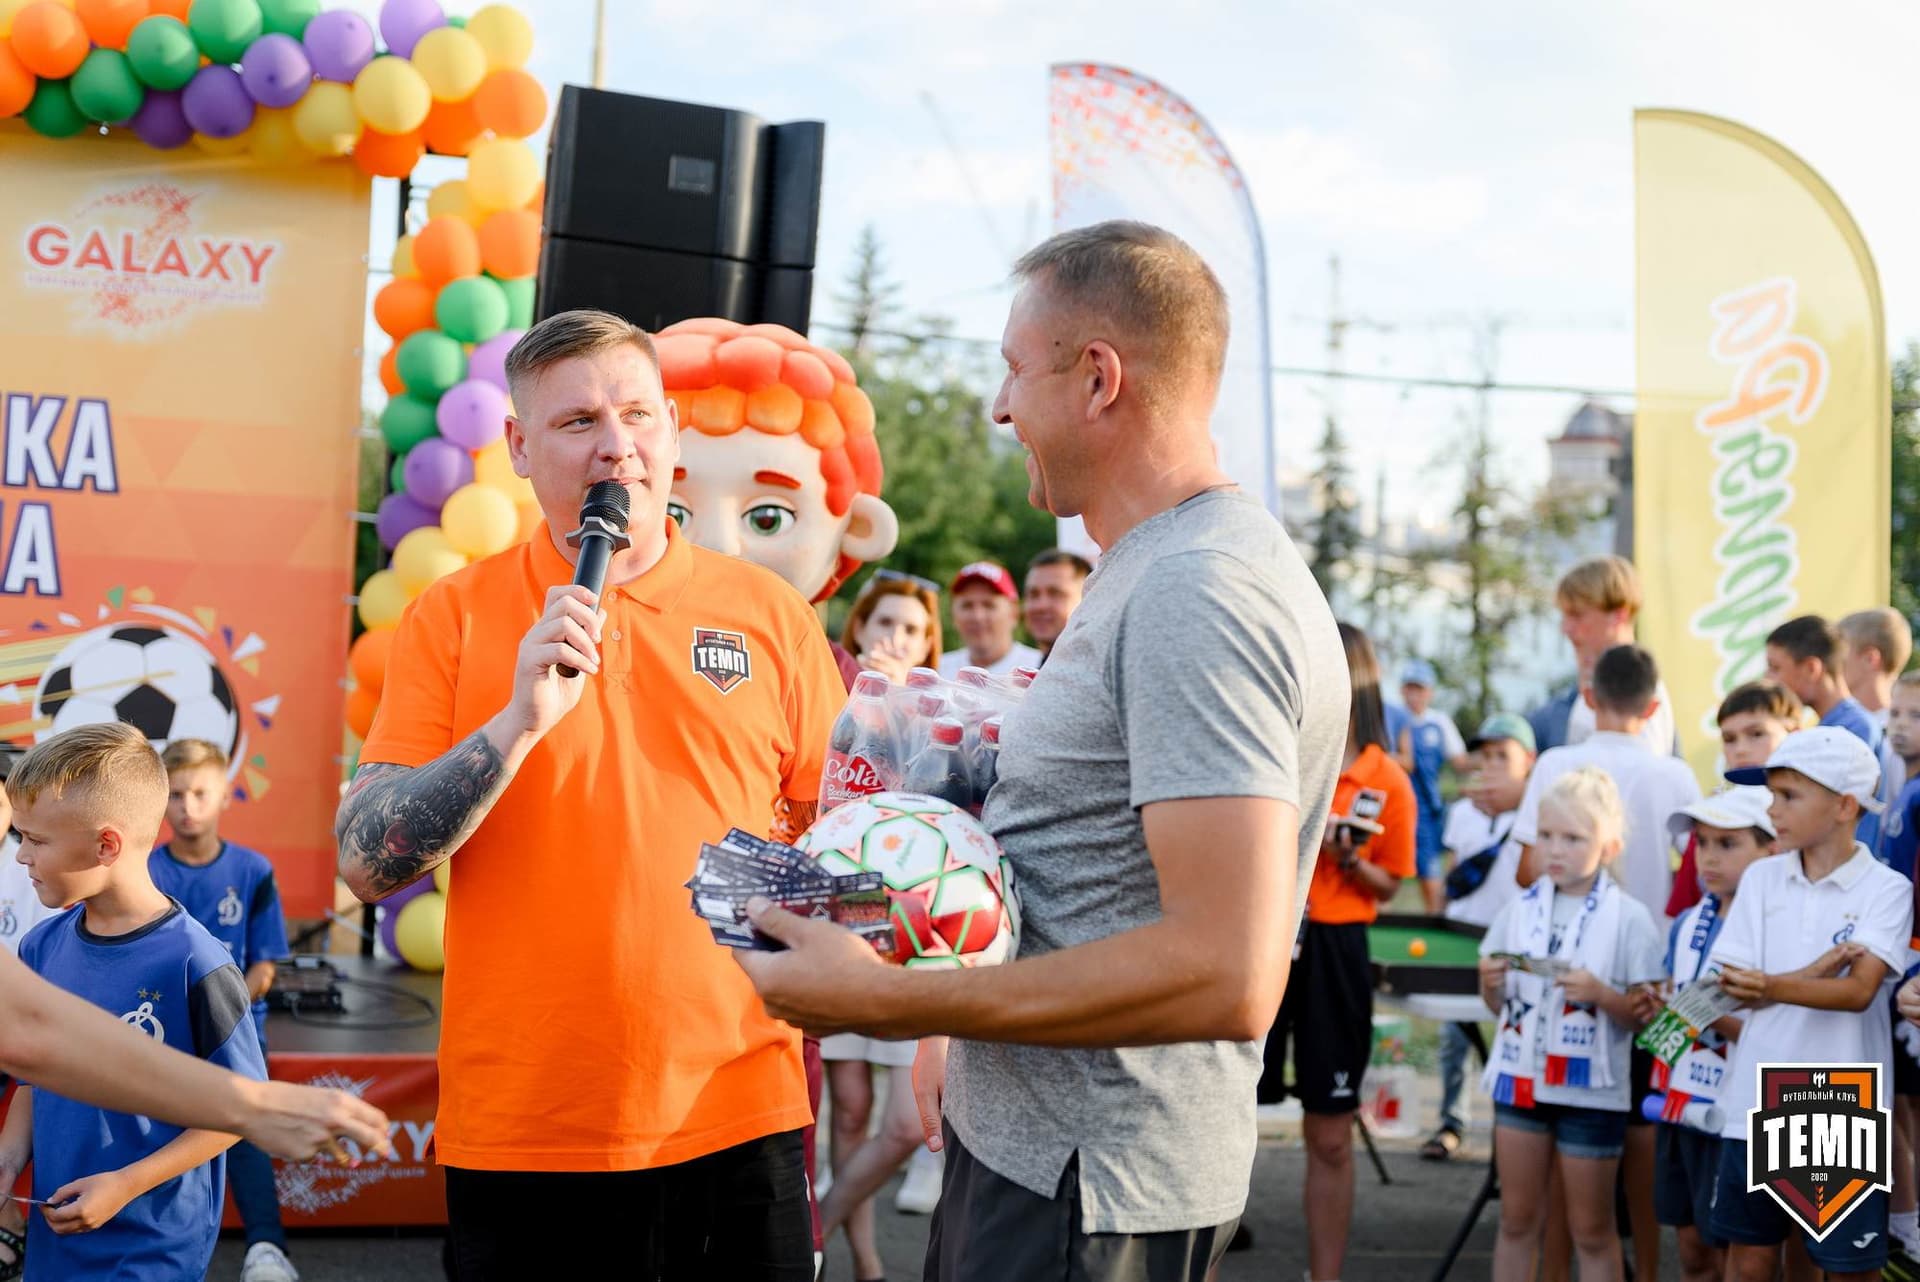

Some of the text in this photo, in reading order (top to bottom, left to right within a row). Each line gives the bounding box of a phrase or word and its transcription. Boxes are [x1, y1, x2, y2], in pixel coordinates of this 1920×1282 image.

[28, 225, 274, 283] GALAXY
[0, 394, 118, 492] КА
[0, 502, 61, 596] А
[697, 647, 746, 675] ТЕМП
[826, 758, 879, 787] Cola
[1689, 1061, 1724, 1088] 2017
